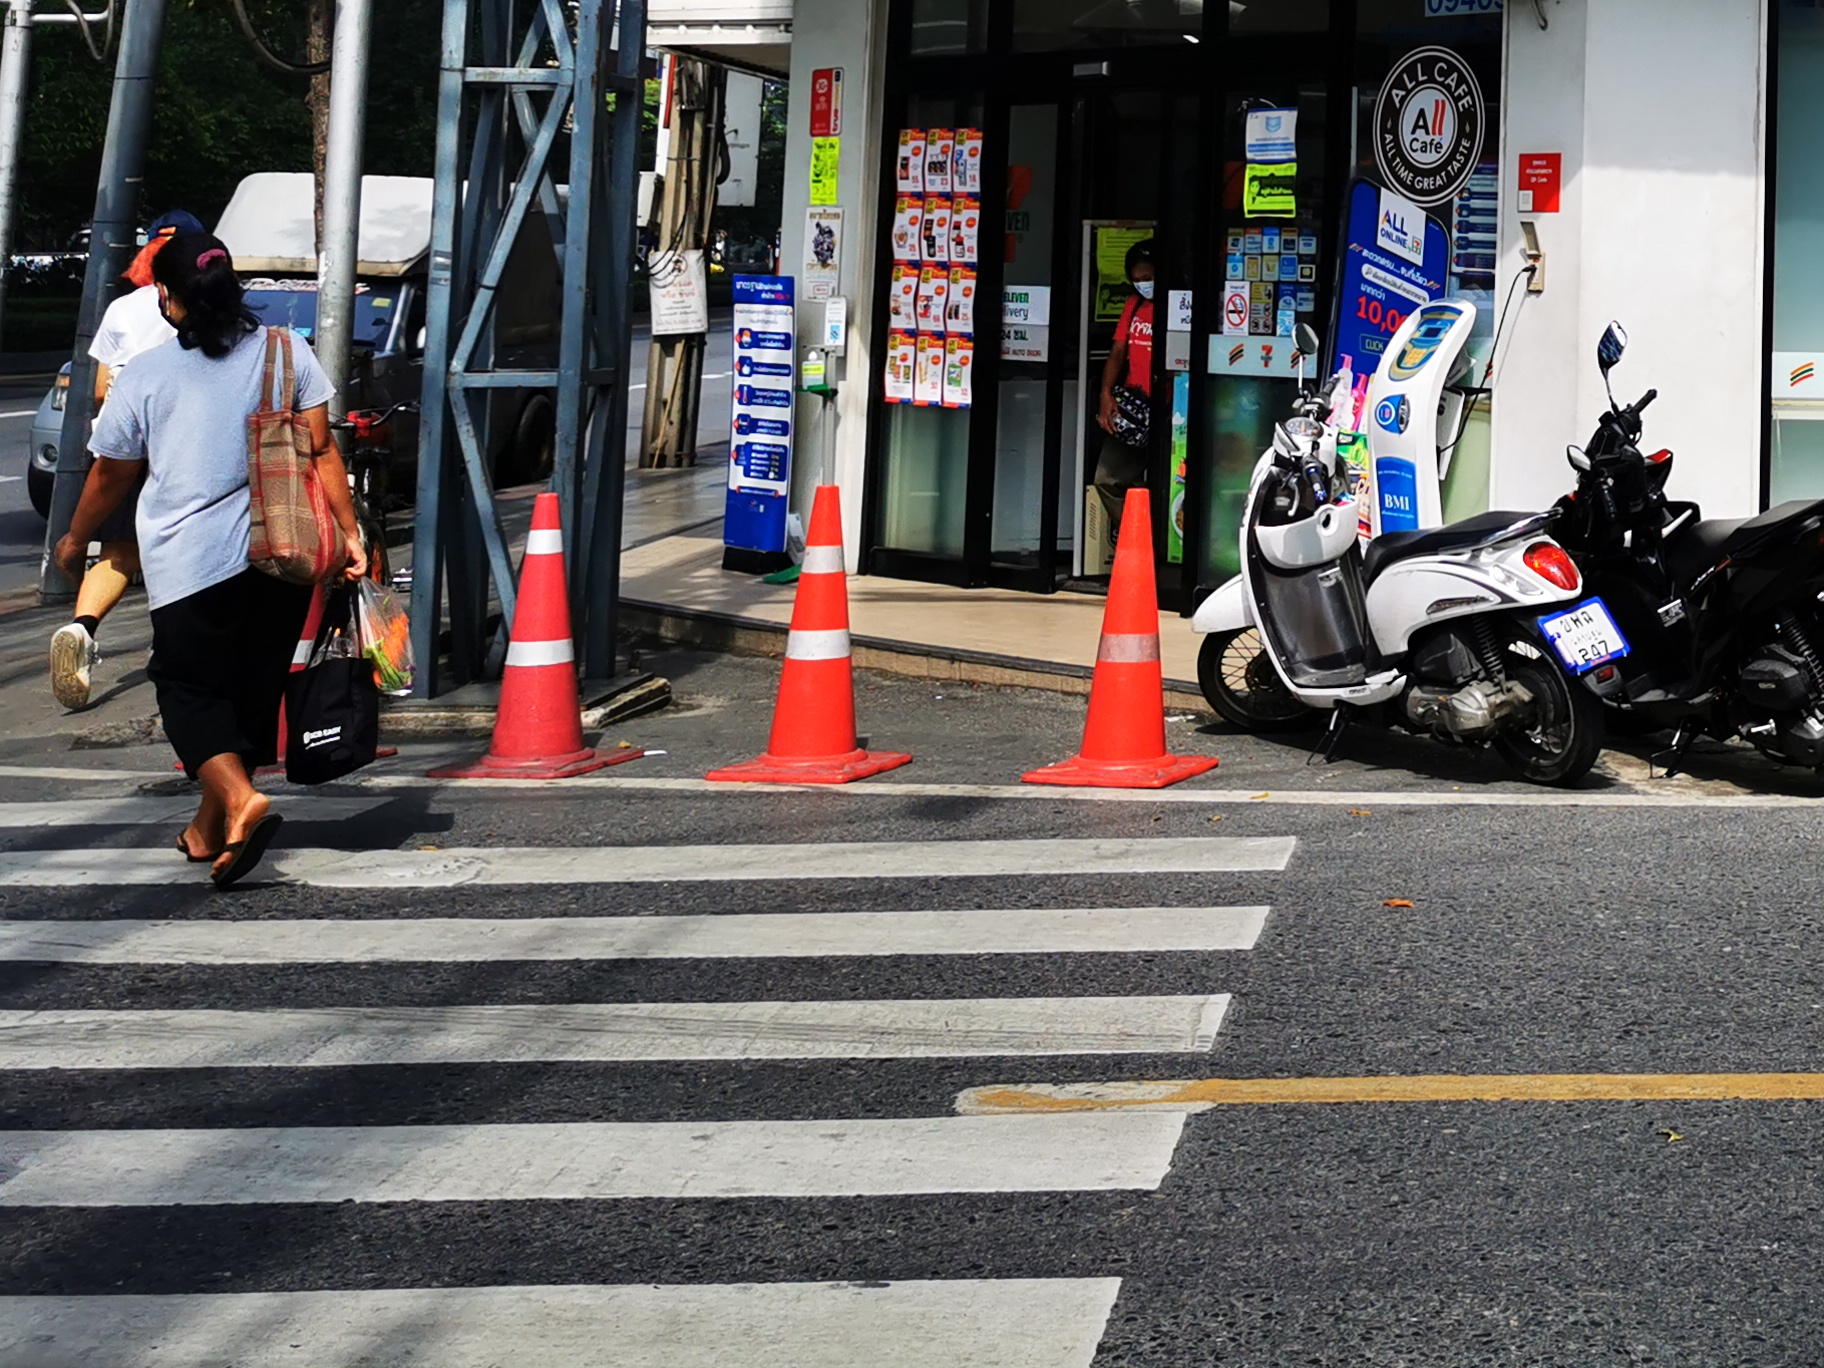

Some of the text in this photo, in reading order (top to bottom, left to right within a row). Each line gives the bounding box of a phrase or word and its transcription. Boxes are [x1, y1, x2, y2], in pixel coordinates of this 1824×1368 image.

[1391, 62, 1428, 109] ALL
[1410, 99, 1447, 137] All
[1409, 137, 1443, 154] Café
[1384, 133, 1471, 190] ALL TIME GREAT TASTE
[1382, 209, 1408, 237] ALL
[1380, 227, 1408, 249] ONLINE
[1384, 493, 1410, 511] BMI
[1578, 639, 1609, 662] 247
